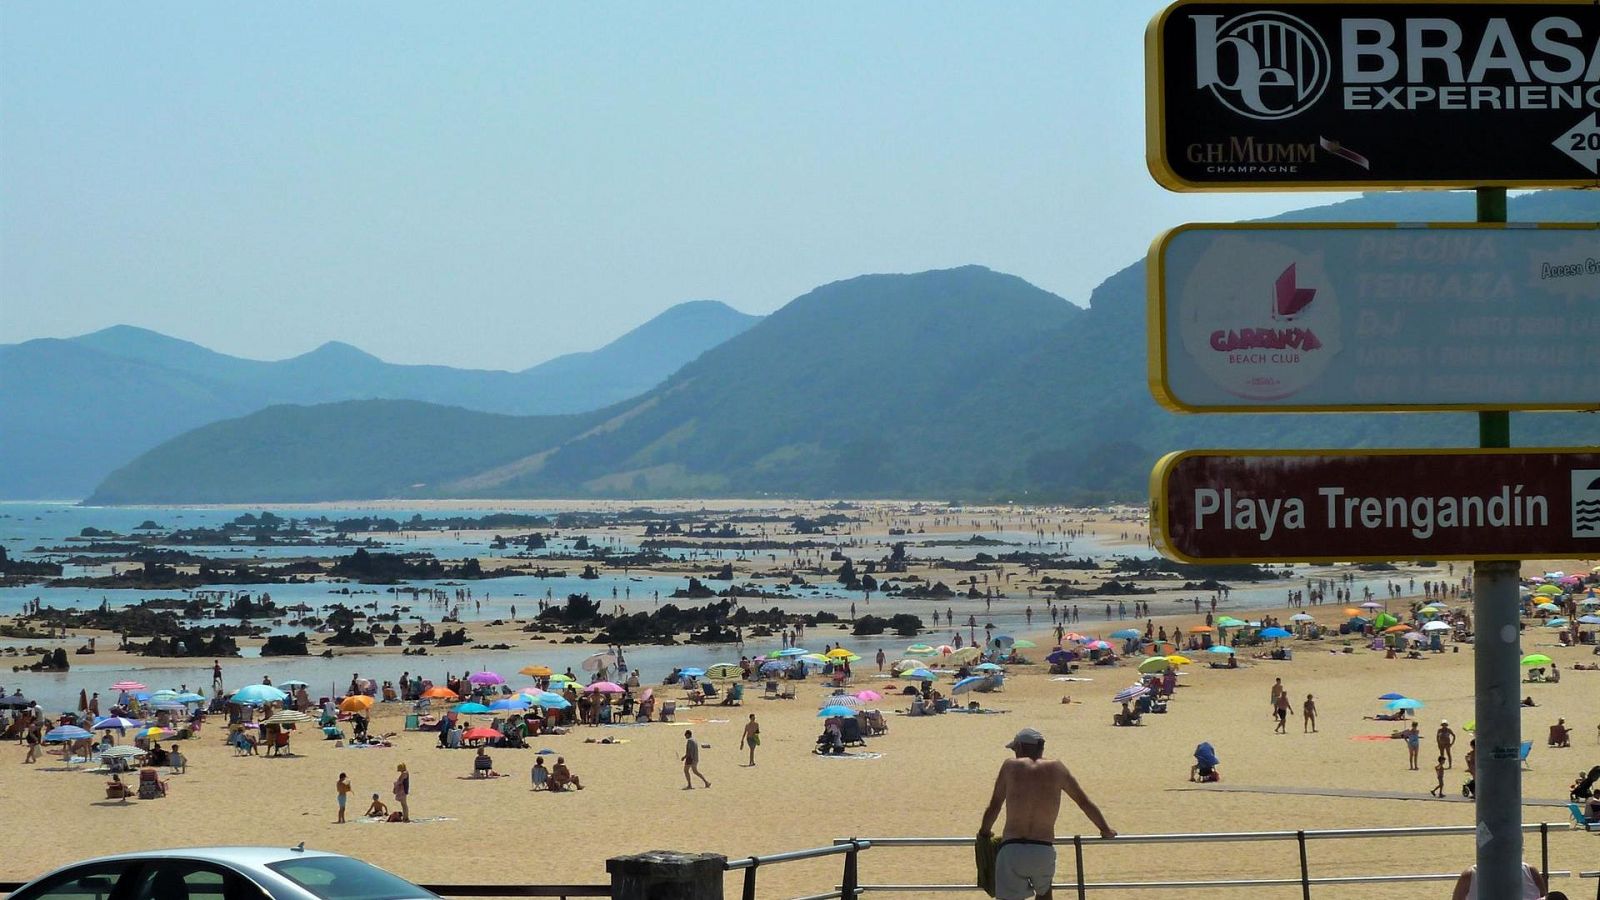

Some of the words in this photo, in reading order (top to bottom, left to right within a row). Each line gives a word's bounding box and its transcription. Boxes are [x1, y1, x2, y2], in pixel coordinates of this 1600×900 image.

[1342, 16, 1600, 83] BRAS
[1358, 236, 1497, 260] PISCINA
[1541, 262, 1584, 279] Acceso
[1358, 272, 1515, 298] TERRAZA
[1229, 354, 1266, 363] BEACH
[1271, 354, 1301, 363] CLUB
[1194, 488, 1306, 541] Playa
[1318, 484, 1549, 539] Trengandín
